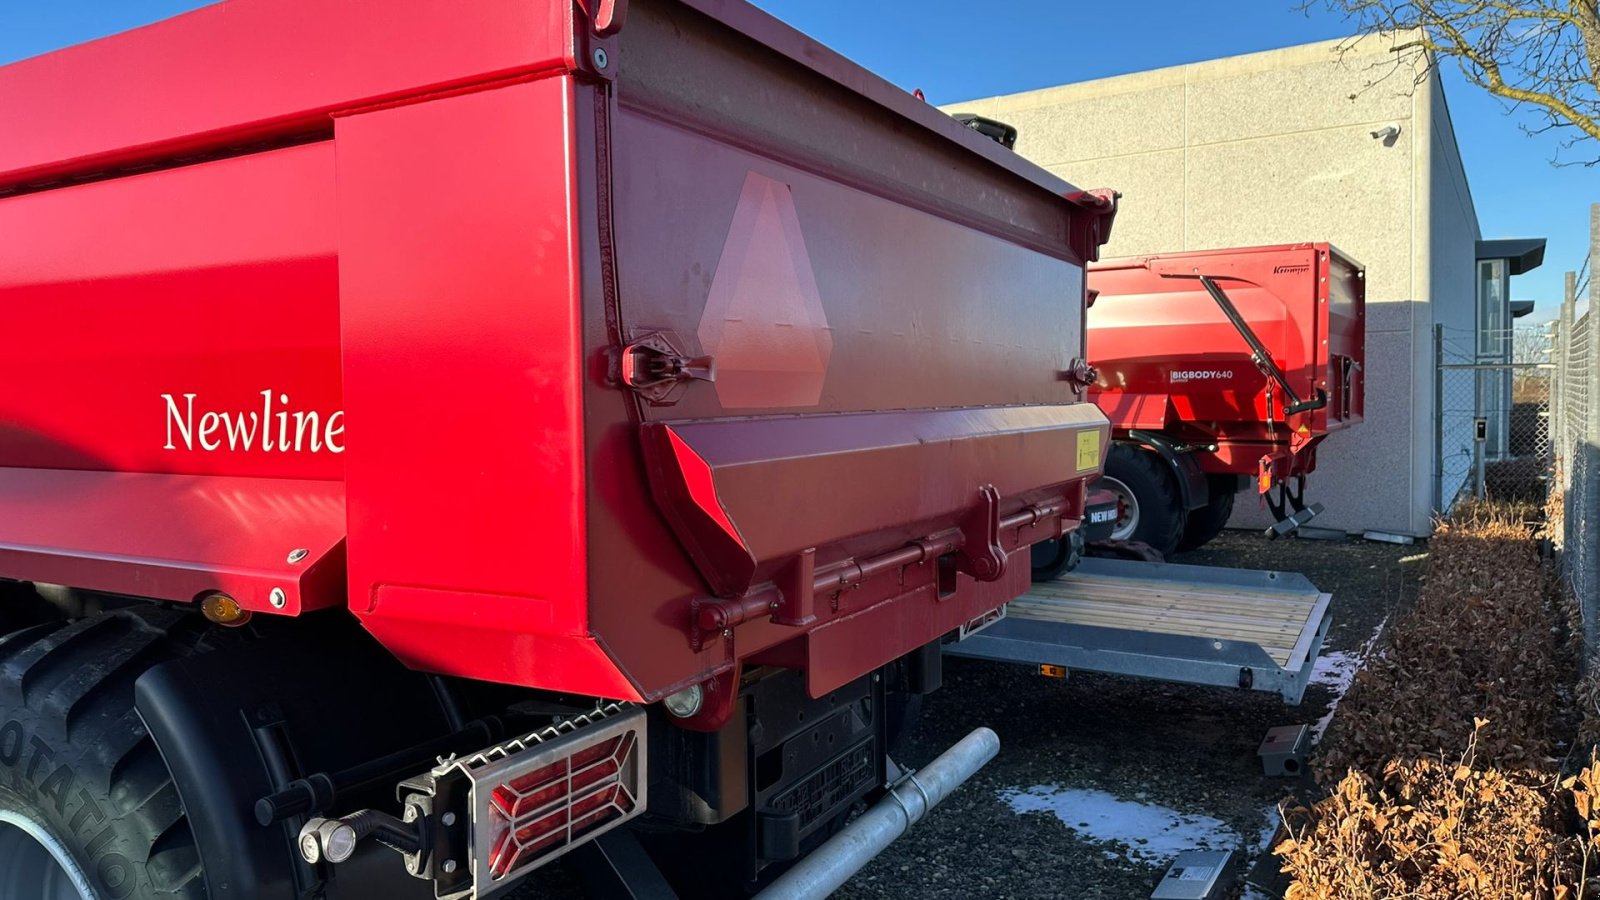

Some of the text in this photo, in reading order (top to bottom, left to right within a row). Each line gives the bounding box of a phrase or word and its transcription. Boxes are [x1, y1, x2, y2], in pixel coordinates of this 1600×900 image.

[1172, 370, 1233, 379] BIGBODY640
[160, 389, 345, 453] Newline
[1091, 511, 1108, 523] NEW
